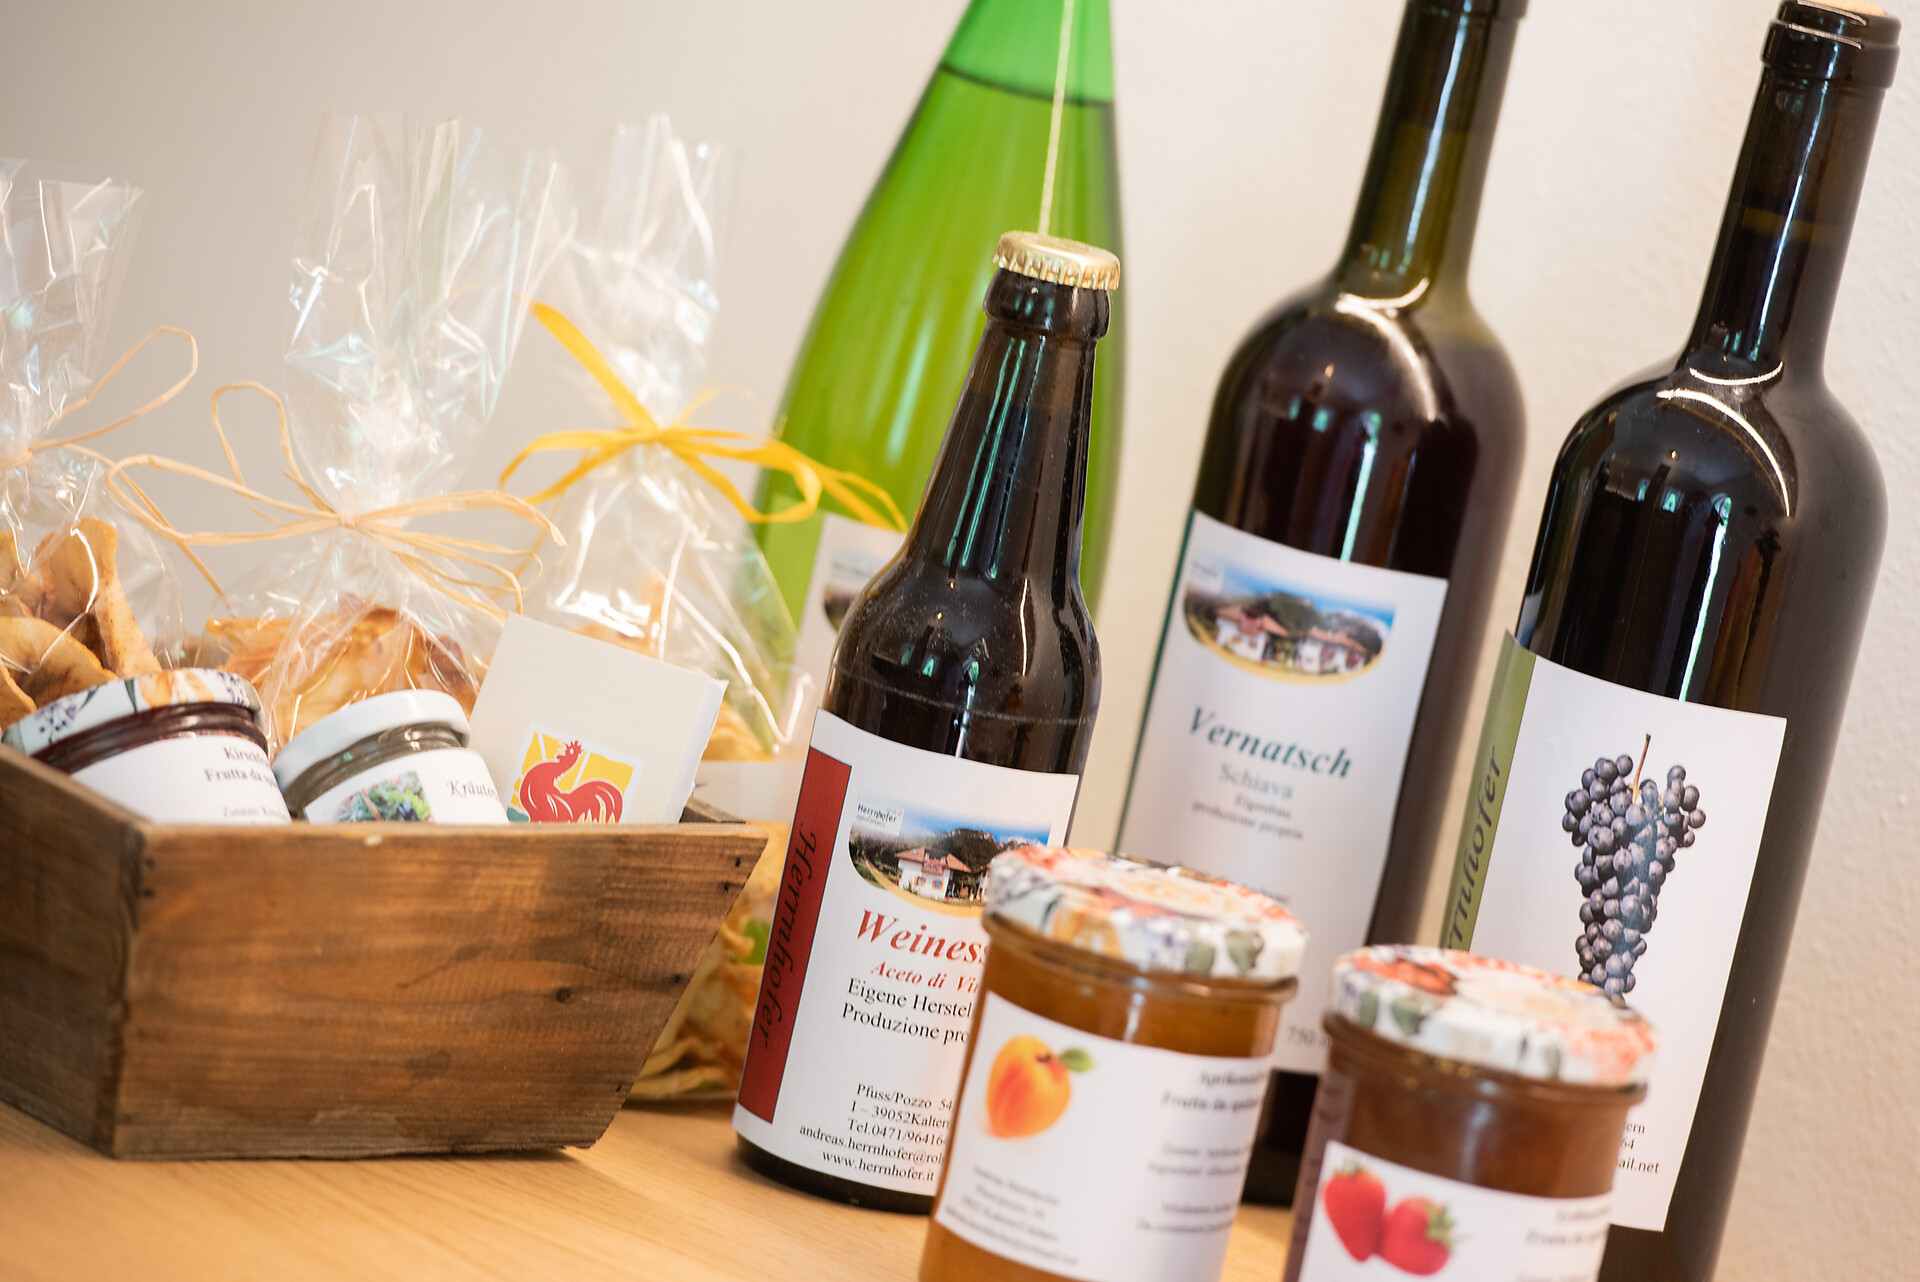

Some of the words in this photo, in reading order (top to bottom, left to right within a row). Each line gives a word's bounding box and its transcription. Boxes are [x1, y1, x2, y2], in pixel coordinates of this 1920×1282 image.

[1188, 705, 1353, 779] Vernatsch
[1217, 762, 1294, 801] Schiava
[857, 802, 896, 823] Herrnhofer
[758, 822, 817, 1049] Herrnhofer
[870, 960, 923, 986] Aceto
[927, 972, 948, 990] di
[847, 977, 908, 1009] Eigene
[912, 993, 973, 1019] Herstel
[841, 1002, 940, 1041] Produzione
[856, 1082, 933, 1110] Pfuss/Pozzo
[848, 1117, 947, 1147] Tel.0471/96416
[1623, 1121, 1647, 1140] ern
[821, 1149, 936, 1184] www.herrnhofer.it
[1615, 1156, 1661, 1175] ail.net
